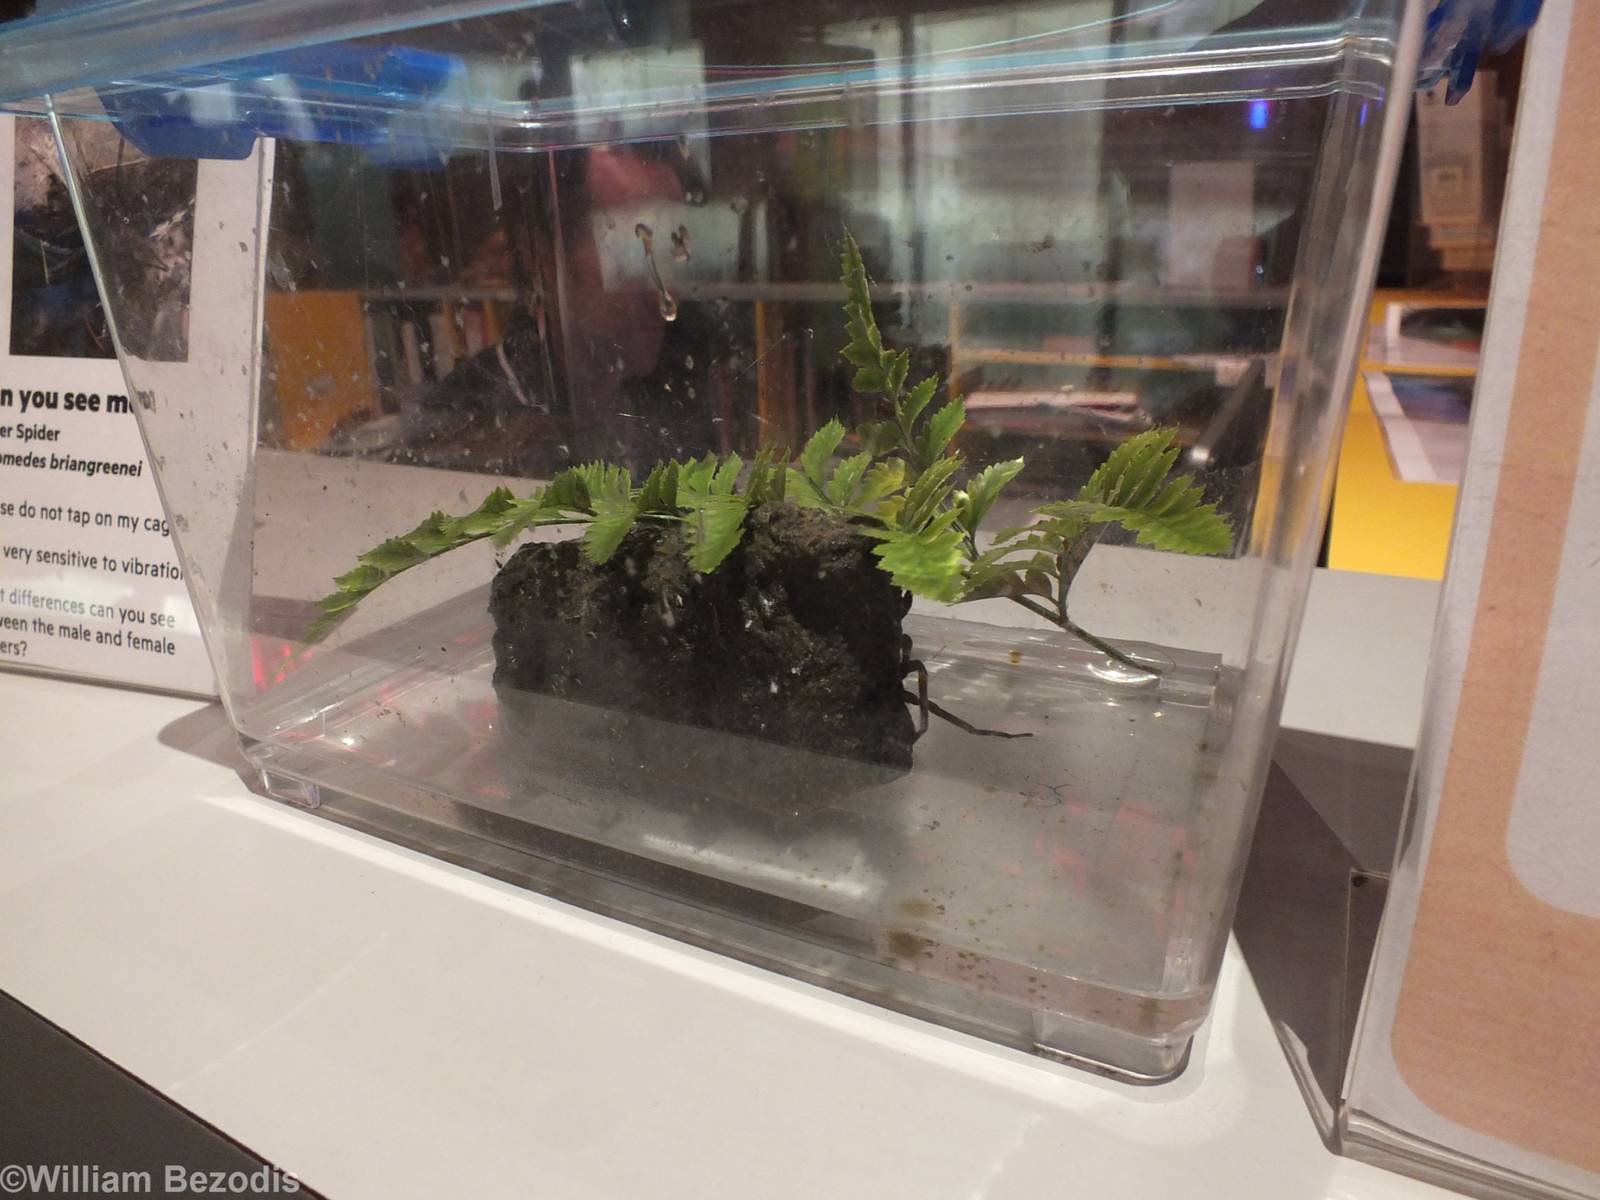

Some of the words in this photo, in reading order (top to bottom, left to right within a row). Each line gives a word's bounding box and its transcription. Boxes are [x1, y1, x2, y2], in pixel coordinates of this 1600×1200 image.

[19, 389, 58, 413] you
[64, 391, 100, 412] see
[106, 394, 134, 414] m
[16, 423, 60, 443] Spider
[50, 452, 142, 477] briangreenei
[0, 502, 14, 516] se
[19, 501, 36, 518] do
[40, 507, 62, 521] not
[67, 509, 90, 527] tap
[95, 513, 112, 526] on
[117, 515, 139, 533] my
[3, 545, 32, 564] very
[36, 549, 97, 570] sensitive
[103, 556, 117, 572] to
[9, 588, 85, 615] differences
[89, 603, 114, 619] can
[118, 609, 145, 625] you
[150, 612, 176, 628] see
[0, 640, 27, 656] ers?
[32, 618, 54, 636] the
[58, 623, 91, 643] male
[96, 629, 122, 647] and
[127, 631, 176, 656] female
